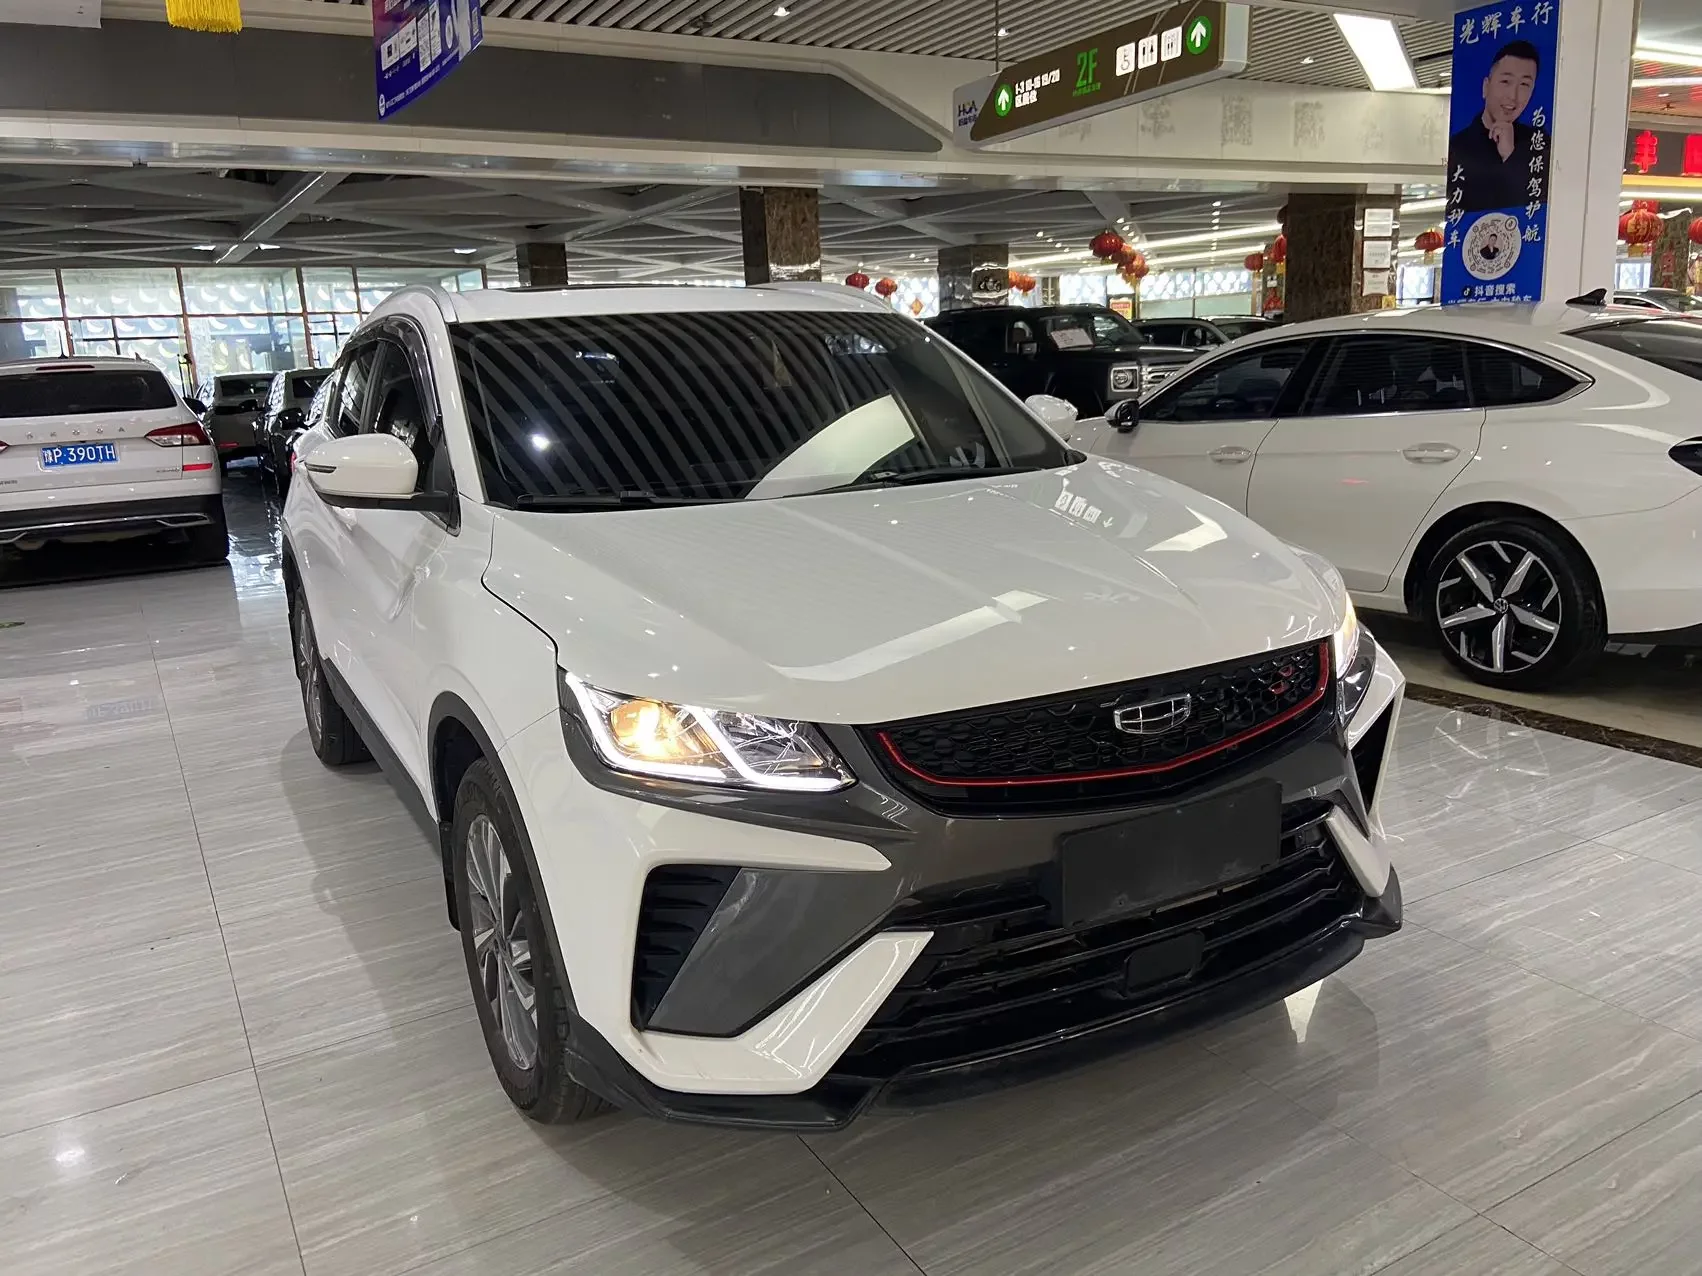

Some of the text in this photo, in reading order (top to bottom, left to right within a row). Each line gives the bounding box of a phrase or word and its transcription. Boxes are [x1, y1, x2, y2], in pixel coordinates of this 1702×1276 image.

[1075, 48, 1098, 87] 2F
[1521, 106, 1547, 242] 为您保驾护航
[1474, 283, 1517, 297] 抖音搜索
